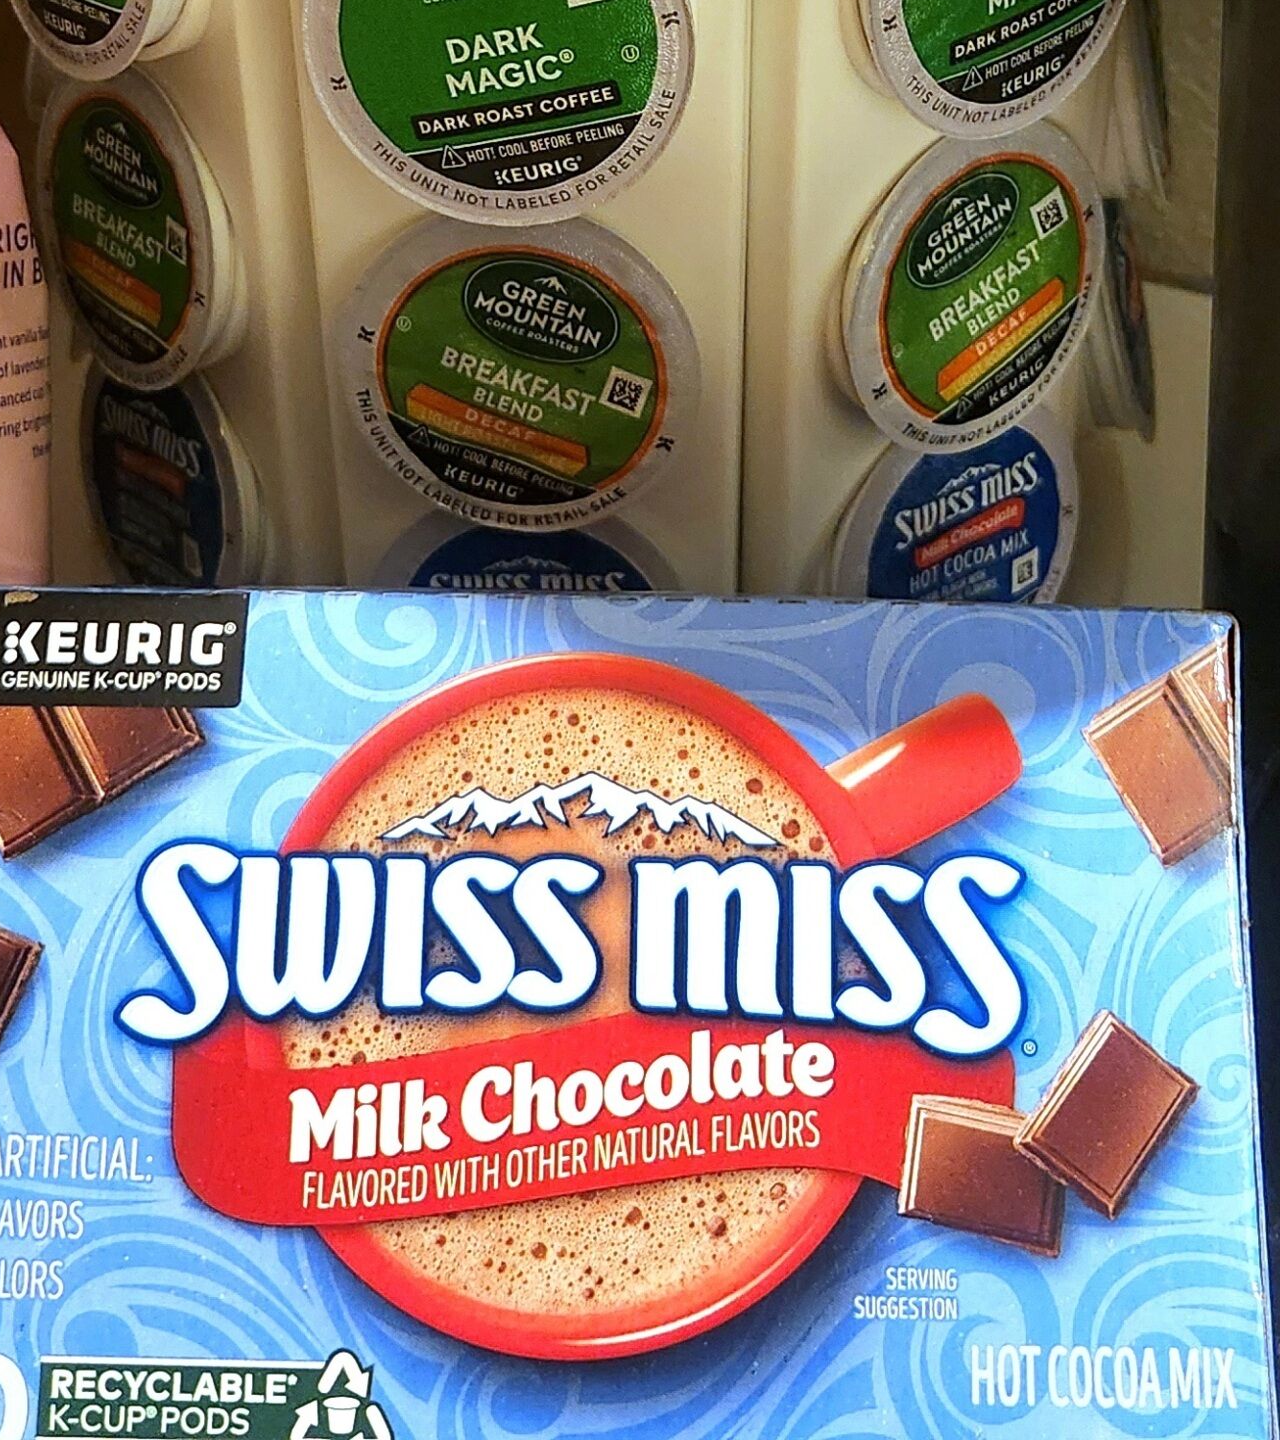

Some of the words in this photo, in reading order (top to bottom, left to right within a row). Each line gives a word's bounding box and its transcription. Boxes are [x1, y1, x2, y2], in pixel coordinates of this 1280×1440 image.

[445, 23, 543, 64] DARK
[418, 114, 470, 135] DARK
[474, 102, 534, 125] ROAST
[540, 86, 615, 114] COFFEE
[466, 146, 497, 163] HOT!
[499, 141, 528, 159] COOL
[530, 131, 573, 153] BEFORE
[575, 121, 625, 144] PEELING
[72, 192, 164, 263] BREAKFAST
[916, 198, 1012, 278] MOUNTAIN
[927, 192, 992, 248] GREEN
[3, 260, 25, 289] IN
[928, 239, 1041, 342] BREAKFAST
[474, 290, 602, 349] MOUNTAIN
[502, 279, 586, 321] GREEN
[966, 287, 1021, 336] BLEND
[440, 346, 597, 416] BREAKFAST
[472, 388, 544, 423] BLEND
[944, 543, 996, 578] COCOA
[1000, 529, 1030, 557] MIX
[0, 669, 92, 693] GENUINE
[163, 671, 223, 693] PODS
[289, 1082, 452, 1165] Milk
[458, 1030, 836, 1129] Chocolate
[302, 1165, 428, 1209] FLAVORED
[434, 1158, 502, 1200] WITH
[505, 1147, 589, 1194] OTHER
[592, 1127, 705, 1178] NATURAL
[709, 1110, 822, 1155] FLAVORS
[886, 1266, 958, 1292] SERVING
[853, 1295, 958, 1321] SUGGESTION
[970, 1343, 1043, 1407] HOT
[1047, 1345, 1164, 1409] COCOA
[1168, 1346, 1238, 1409] MIX
[159, 1406, 250, 1435] PODS
